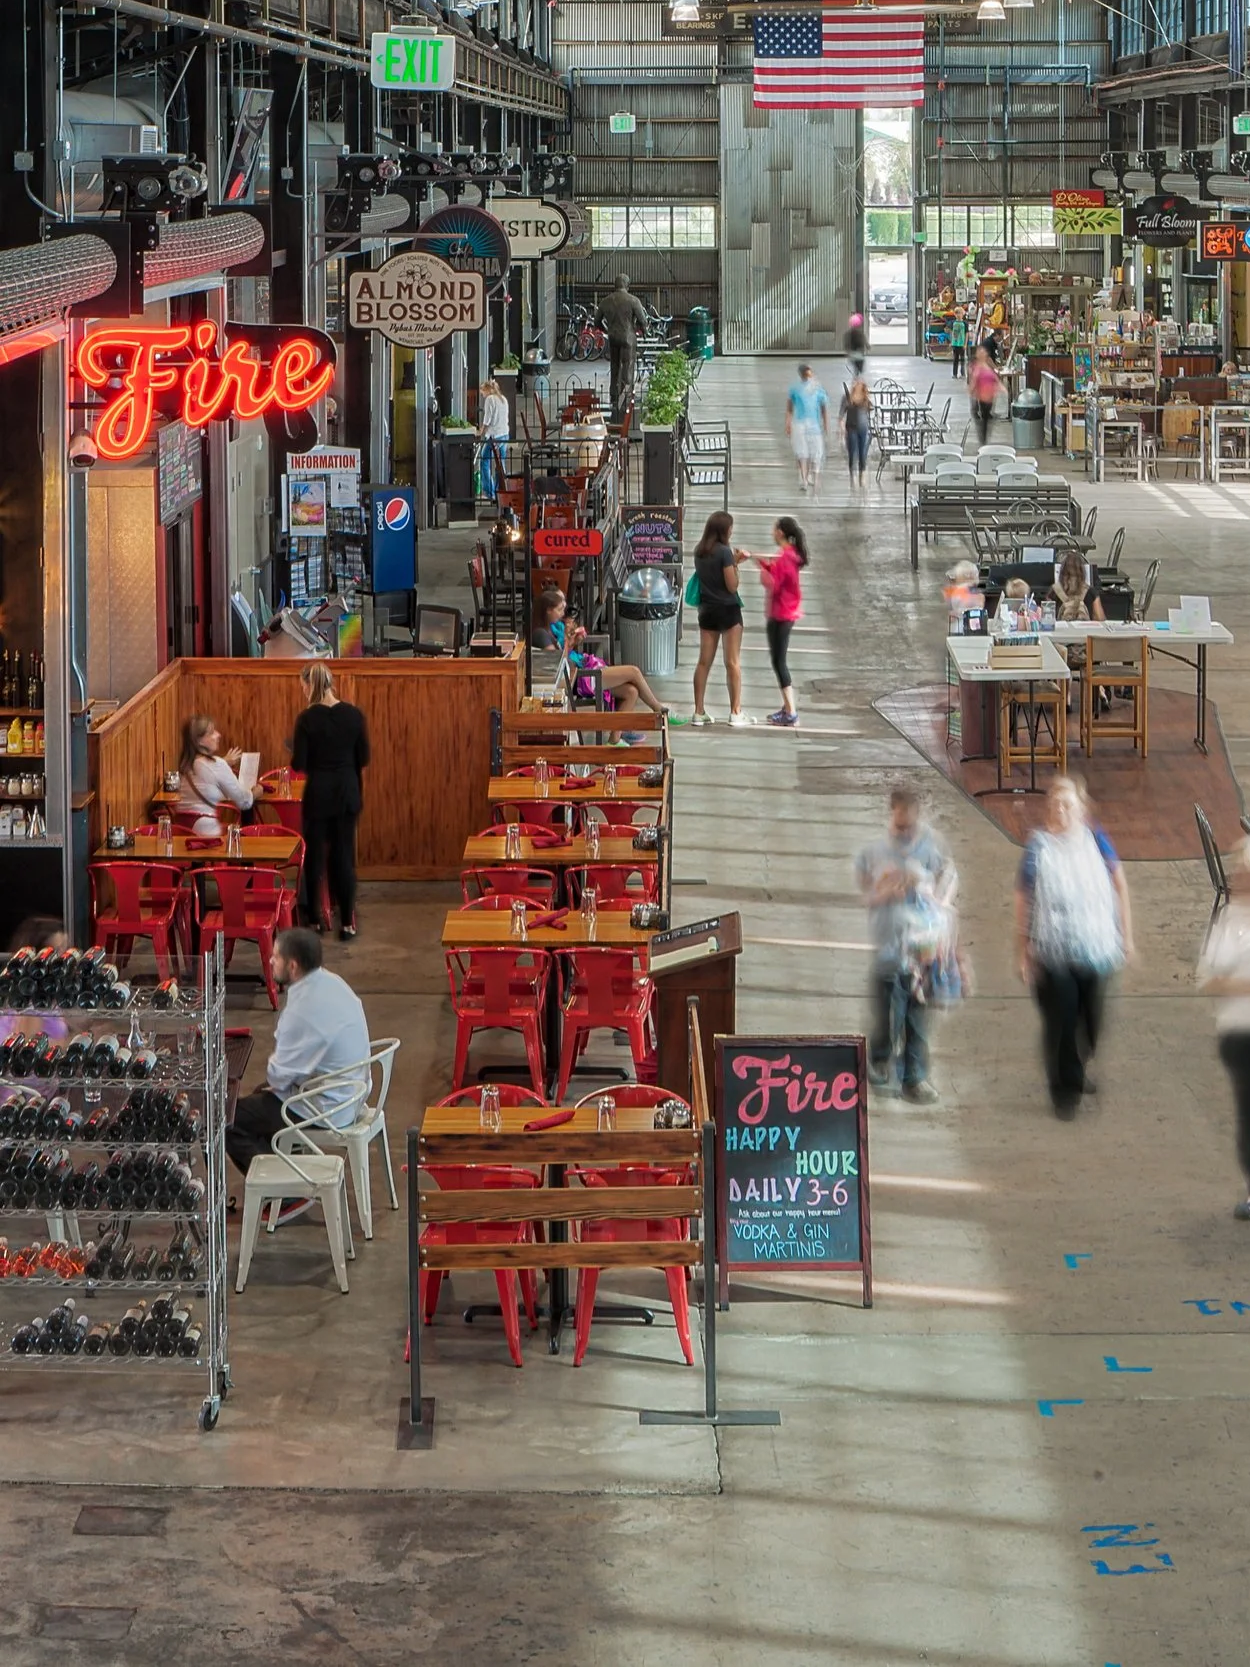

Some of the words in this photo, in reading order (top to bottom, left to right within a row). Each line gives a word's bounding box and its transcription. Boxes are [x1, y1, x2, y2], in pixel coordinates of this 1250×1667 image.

[676, 21, 716, 29] BEARINGS
[705, 12, 724, 20] SKF
[927, 20, 961, 28] PARTS
[385, 38, 444, 83] EXIT
[1136, 213, 1161, 228] Full
[1161, 213, 1196, 228] Bloom
[356, 277, 477, 300] ALMOND
[356, 302, 476, 324] BLOSSOM
[414, 323, 445, 332] Market
[77, 320, 335, 461] Fire
[291, 454, 356, 470] INFORMATION
[376, 501, 385, 531] pepsi
[634, 522, 673, 534] NUTS
[544, 531, 590, 548] cured
[732, 1054, 858, 1125] Fire
[726, 1126, 801, 1152] HAPPY
[796, 1150, 858, 1176] HOUR
[729, 1178, 802, 1203] DAILY
[806, 1178, 848, 1207] 3-6
[738, 1208, 750, 1218] Ask
[752, 1209, 770, 1218] about
[785, 1209, 806, 1220] happy
[734, 1223, 781, 1240] VODKA
[786, 1222, 798, 1238] &
[804, 1222, 830, 1239] GIN
[754, 1240, 826, 1260] MARTINIS
